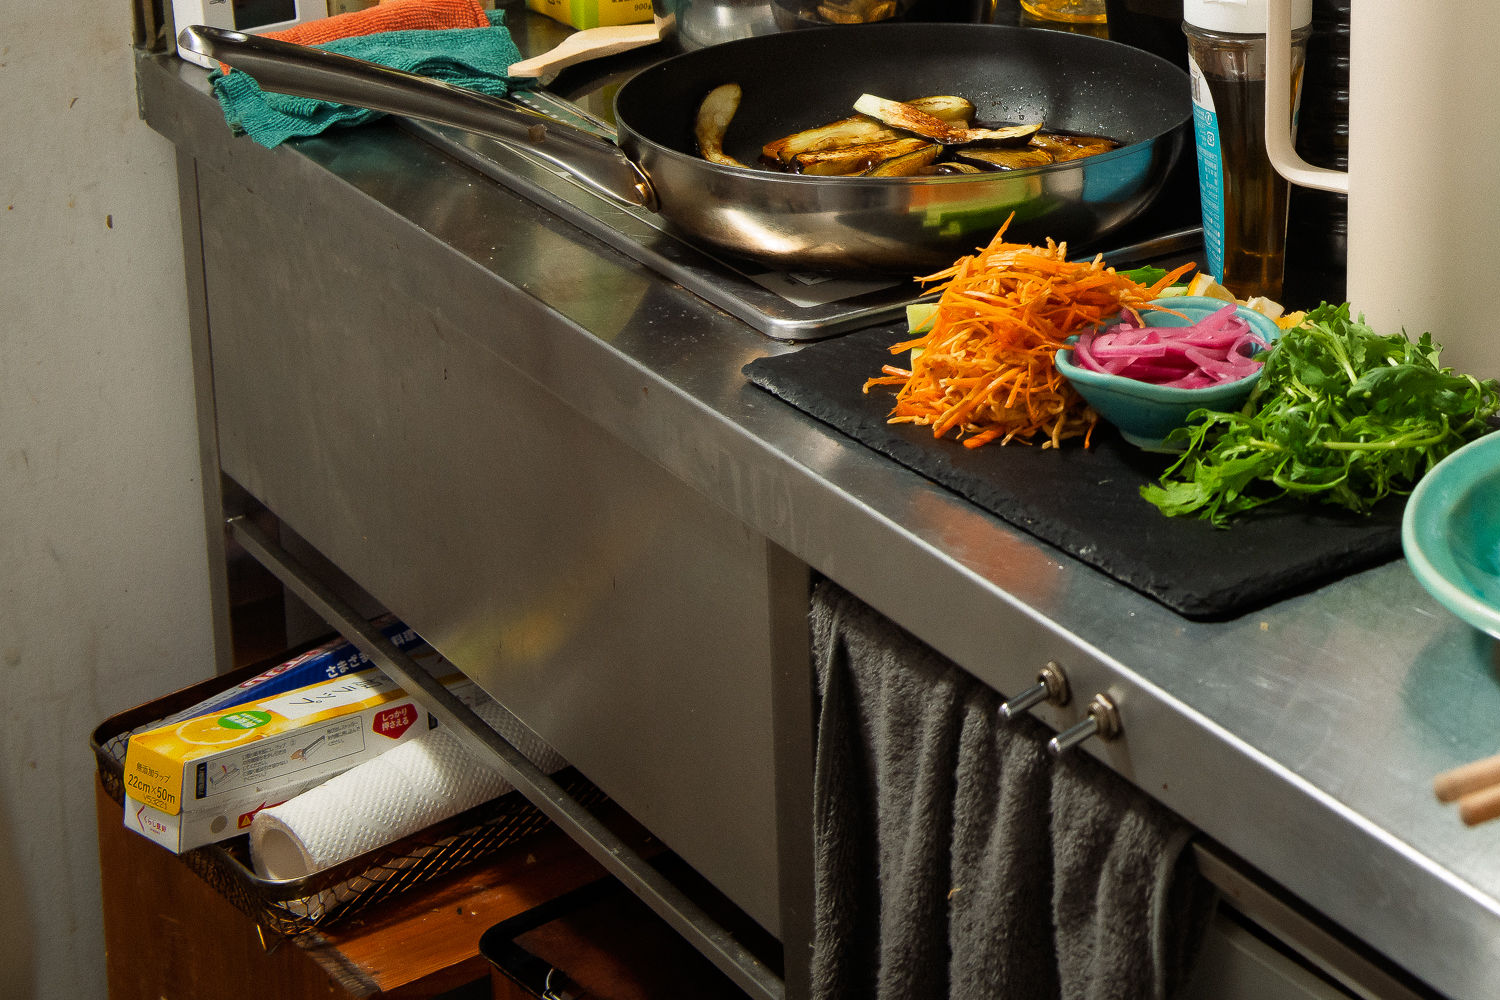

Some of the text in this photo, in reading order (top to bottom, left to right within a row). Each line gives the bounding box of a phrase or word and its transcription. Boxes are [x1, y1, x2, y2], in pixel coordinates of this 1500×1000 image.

[381, 707, 408, 721] しっかり
[381, 716, 409, 731] 押さえる
[136, 762, 171, 784] 無添加ラップ
